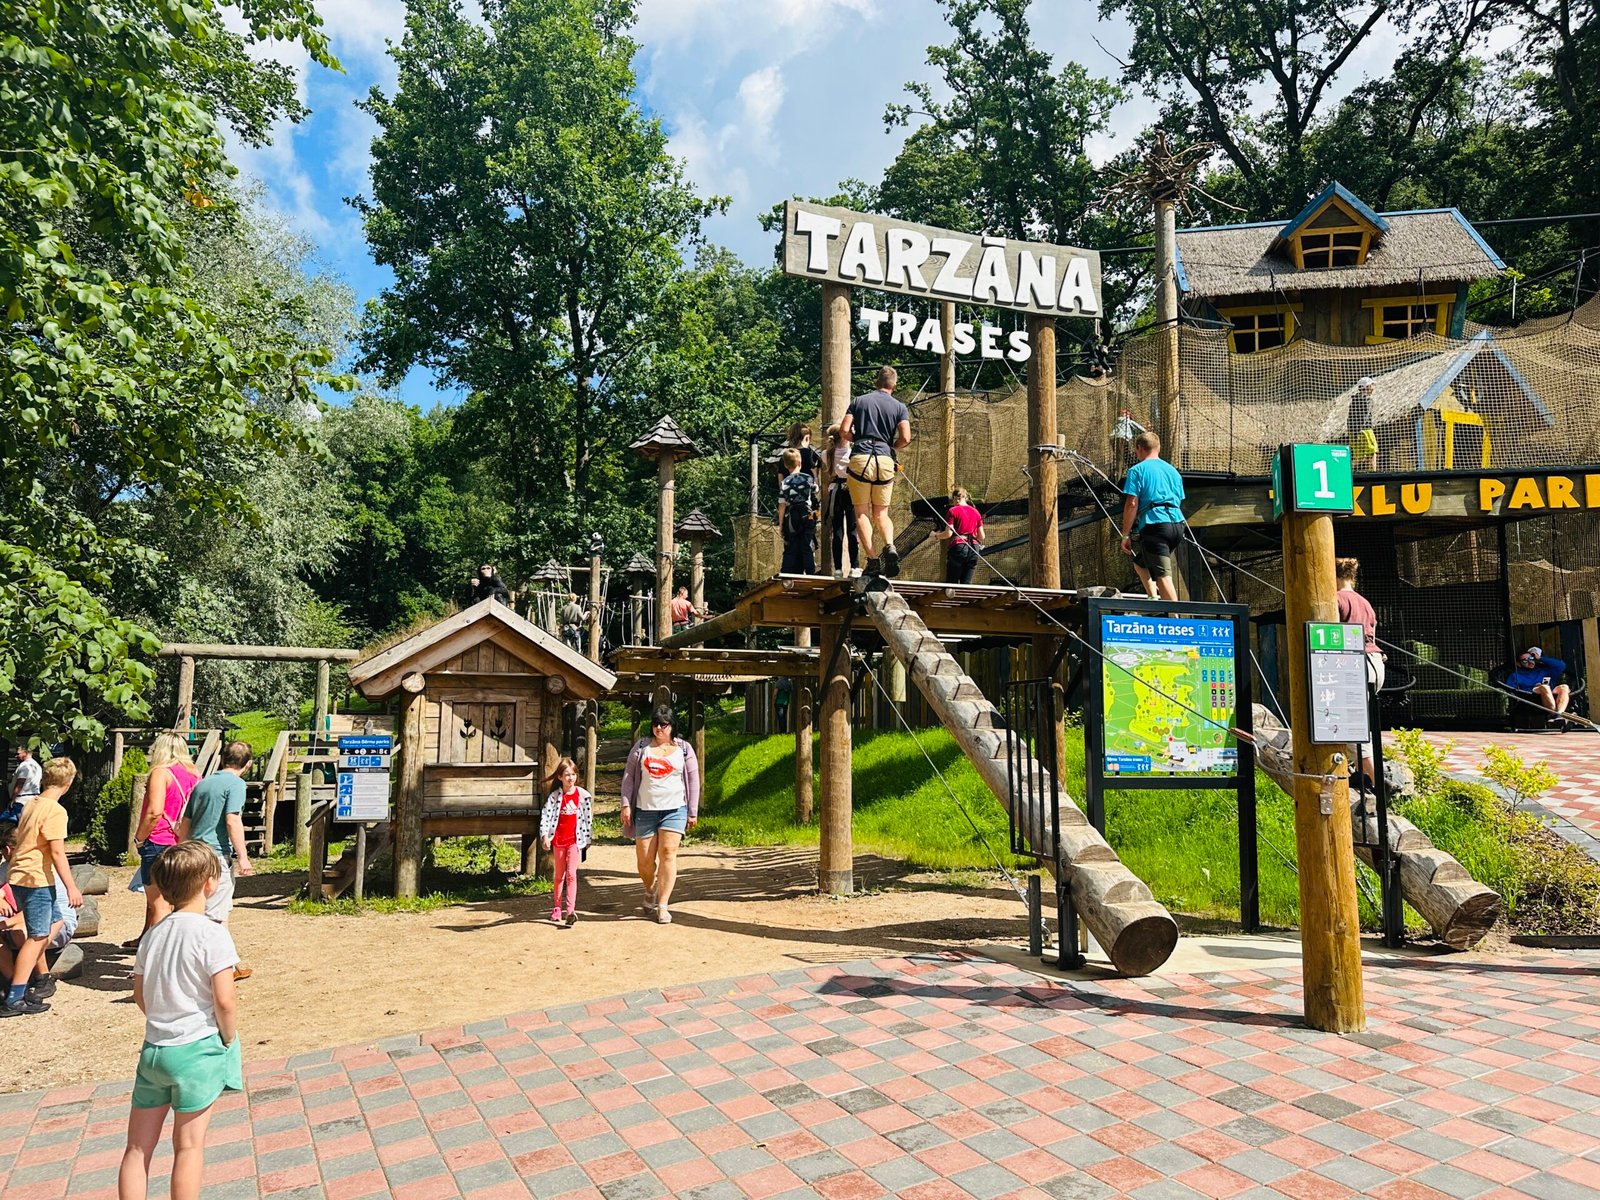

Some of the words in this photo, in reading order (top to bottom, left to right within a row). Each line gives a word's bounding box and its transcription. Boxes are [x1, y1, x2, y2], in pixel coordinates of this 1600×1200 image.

[796, 209, 1098, 313] TARZĀNA
[860, 307, 1032, 362] TRASES
[1312, 460, 1336, 499] 1
[1106, 620, 1154, 635] Tarzāna
[1157, 623, 1195, 636] trases
[1316, 629, 1325, 646] 1
